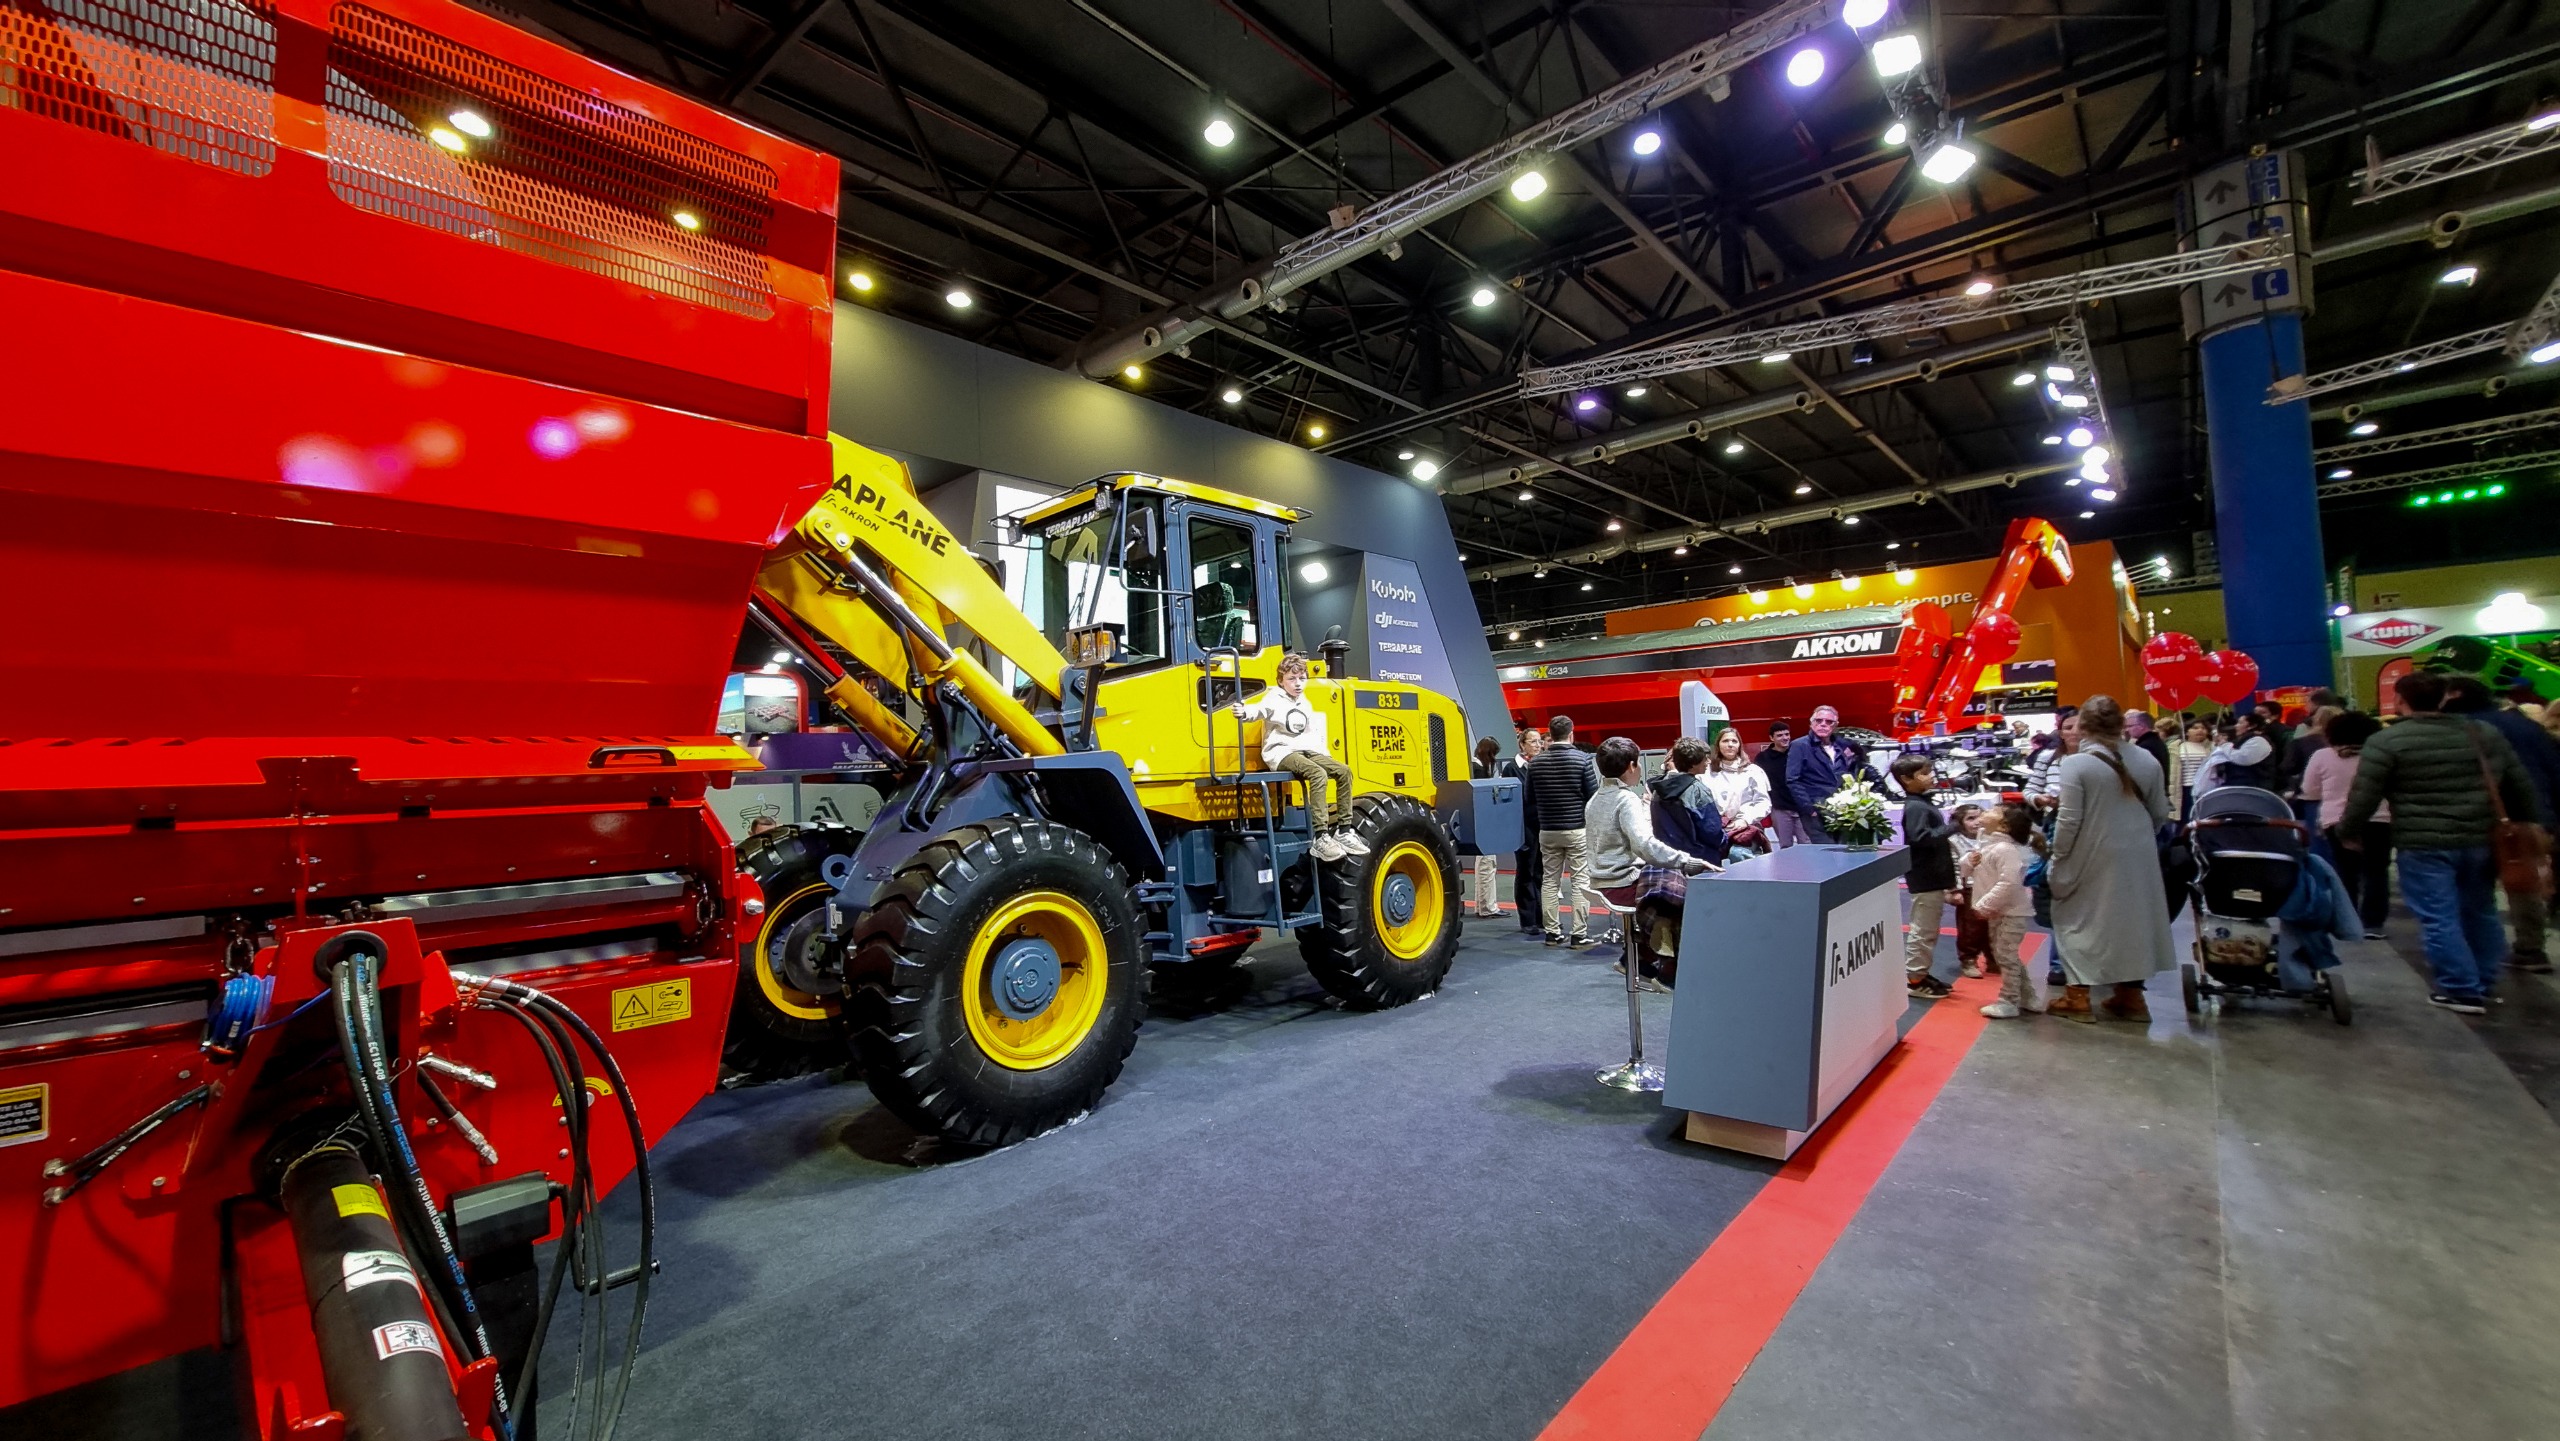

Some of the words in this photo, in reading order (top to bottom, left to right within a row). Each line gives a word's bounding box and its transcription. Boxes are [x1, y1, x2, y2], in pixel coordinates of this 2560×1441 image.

[832, 473, 951, 558] APLANE
[840, 505, 881, 532] AKRON
[1371, 579, 1417, 603] Kubota
[1791, 631, 1883, 659] AKRON
[2362, 624, 2426, 640] KUHN
[1378, 642, 1423, 654] TERRAPLANE
[1378, 669, 1422, 681] PROMETEON
[1378, 693, 1401, 708] 833
[1370, 725, 1405, 738] TERRA
[1371, 738, 1406, 752] PLANE
[1846, 920, 1885, 977] AKRON
[359, 993, 372, 1021] Winner
[368, 1041, 386, 1081] EC118-08
[424, 1199, 438, 1218] BAR
[431, 1215, 447, 1241] (3050
[439, 1235, 453, 1254] PSI)
[475, 1323, 491, 1358] Winner
